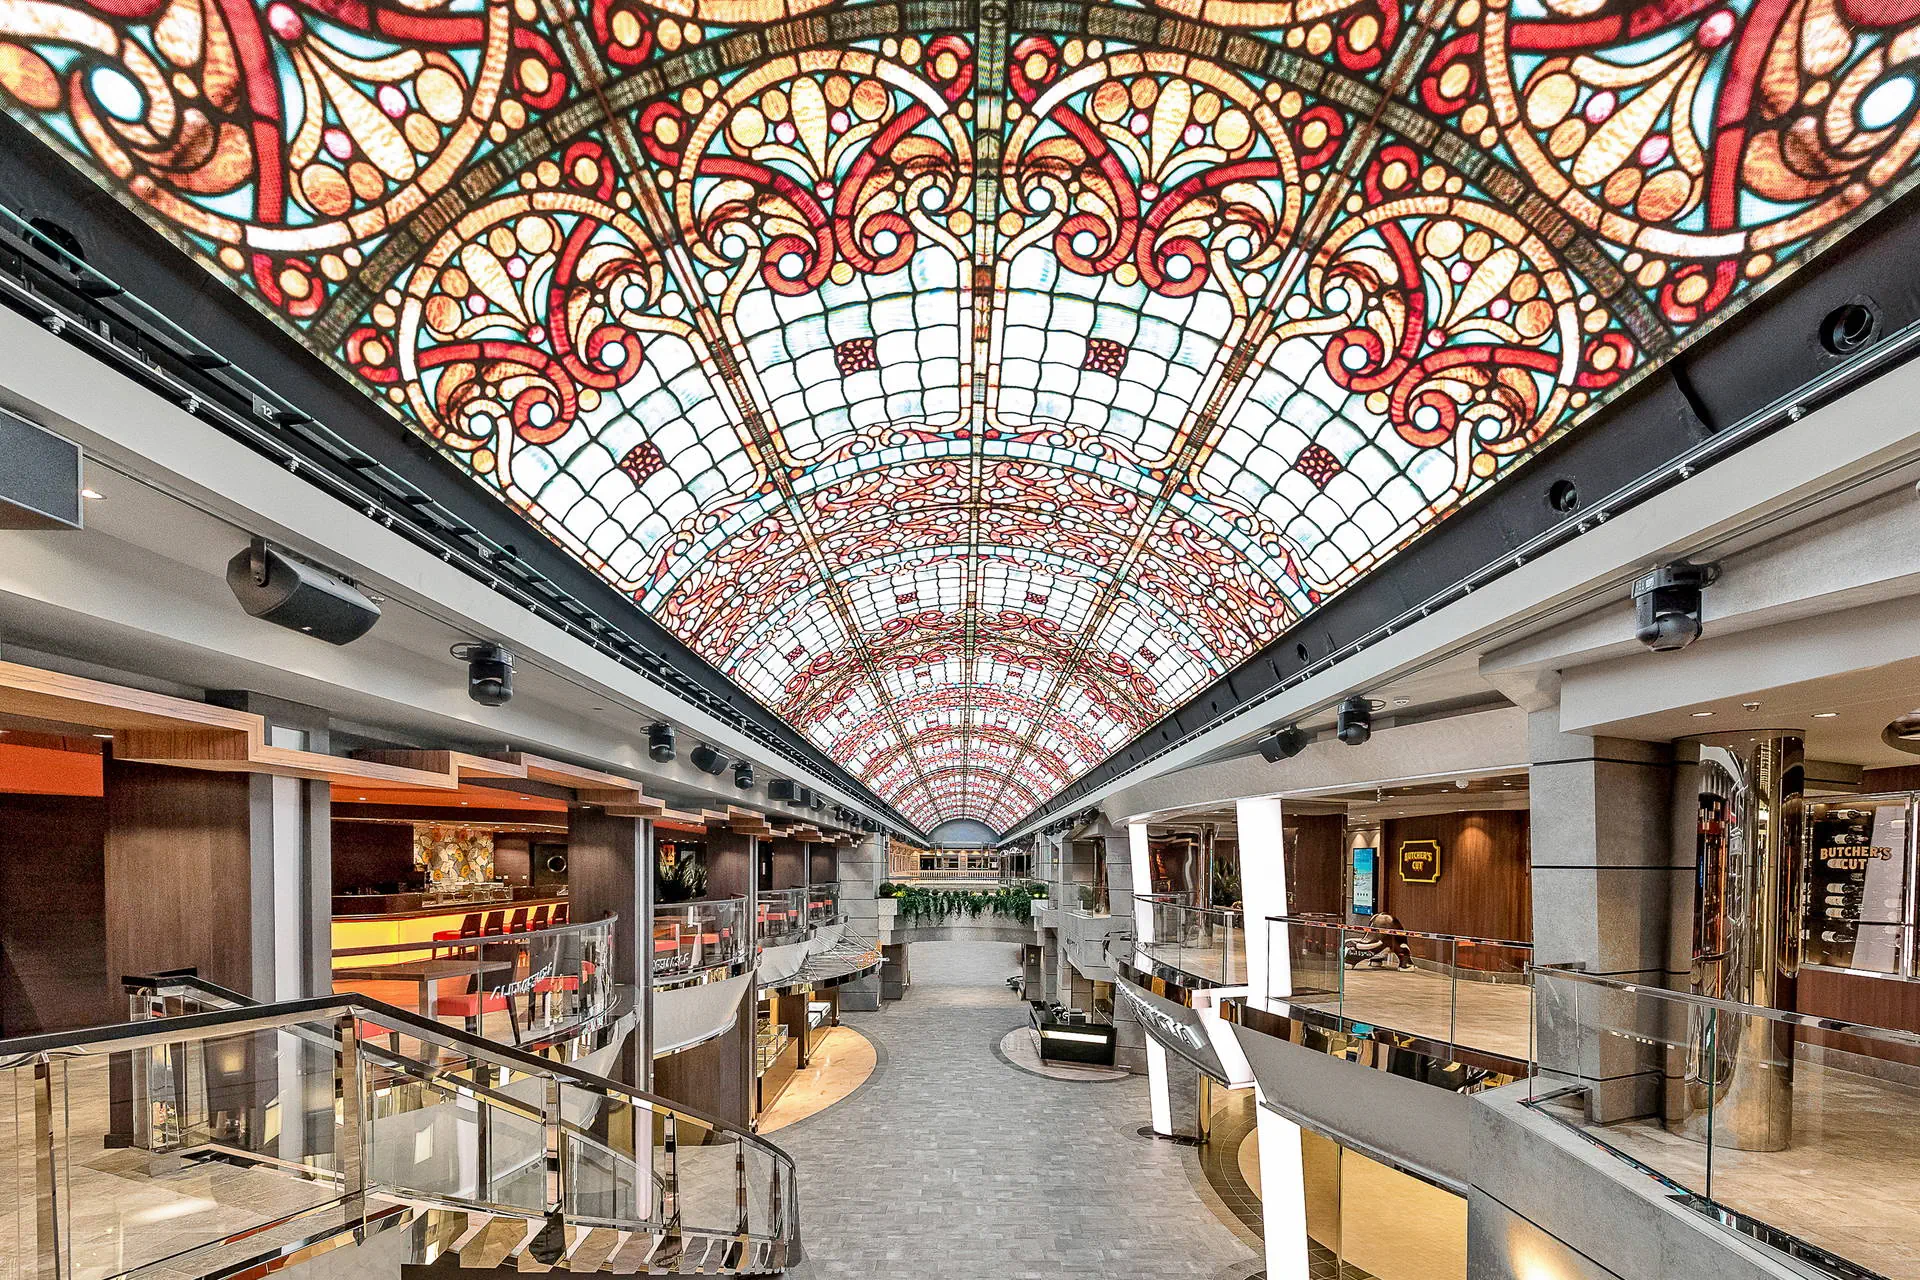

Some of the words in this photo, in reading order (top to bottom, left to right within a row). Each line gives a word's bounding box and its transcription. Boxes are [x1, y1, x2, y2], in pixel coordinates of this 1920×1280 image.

[1404, 852, 1432, 861] BUTCHER'S
[1820, 847, 1892, 860] BUTCHER'S
[1412, 861, 1424, 870] CUT
[1841, 859, 1867, 869] CUT
